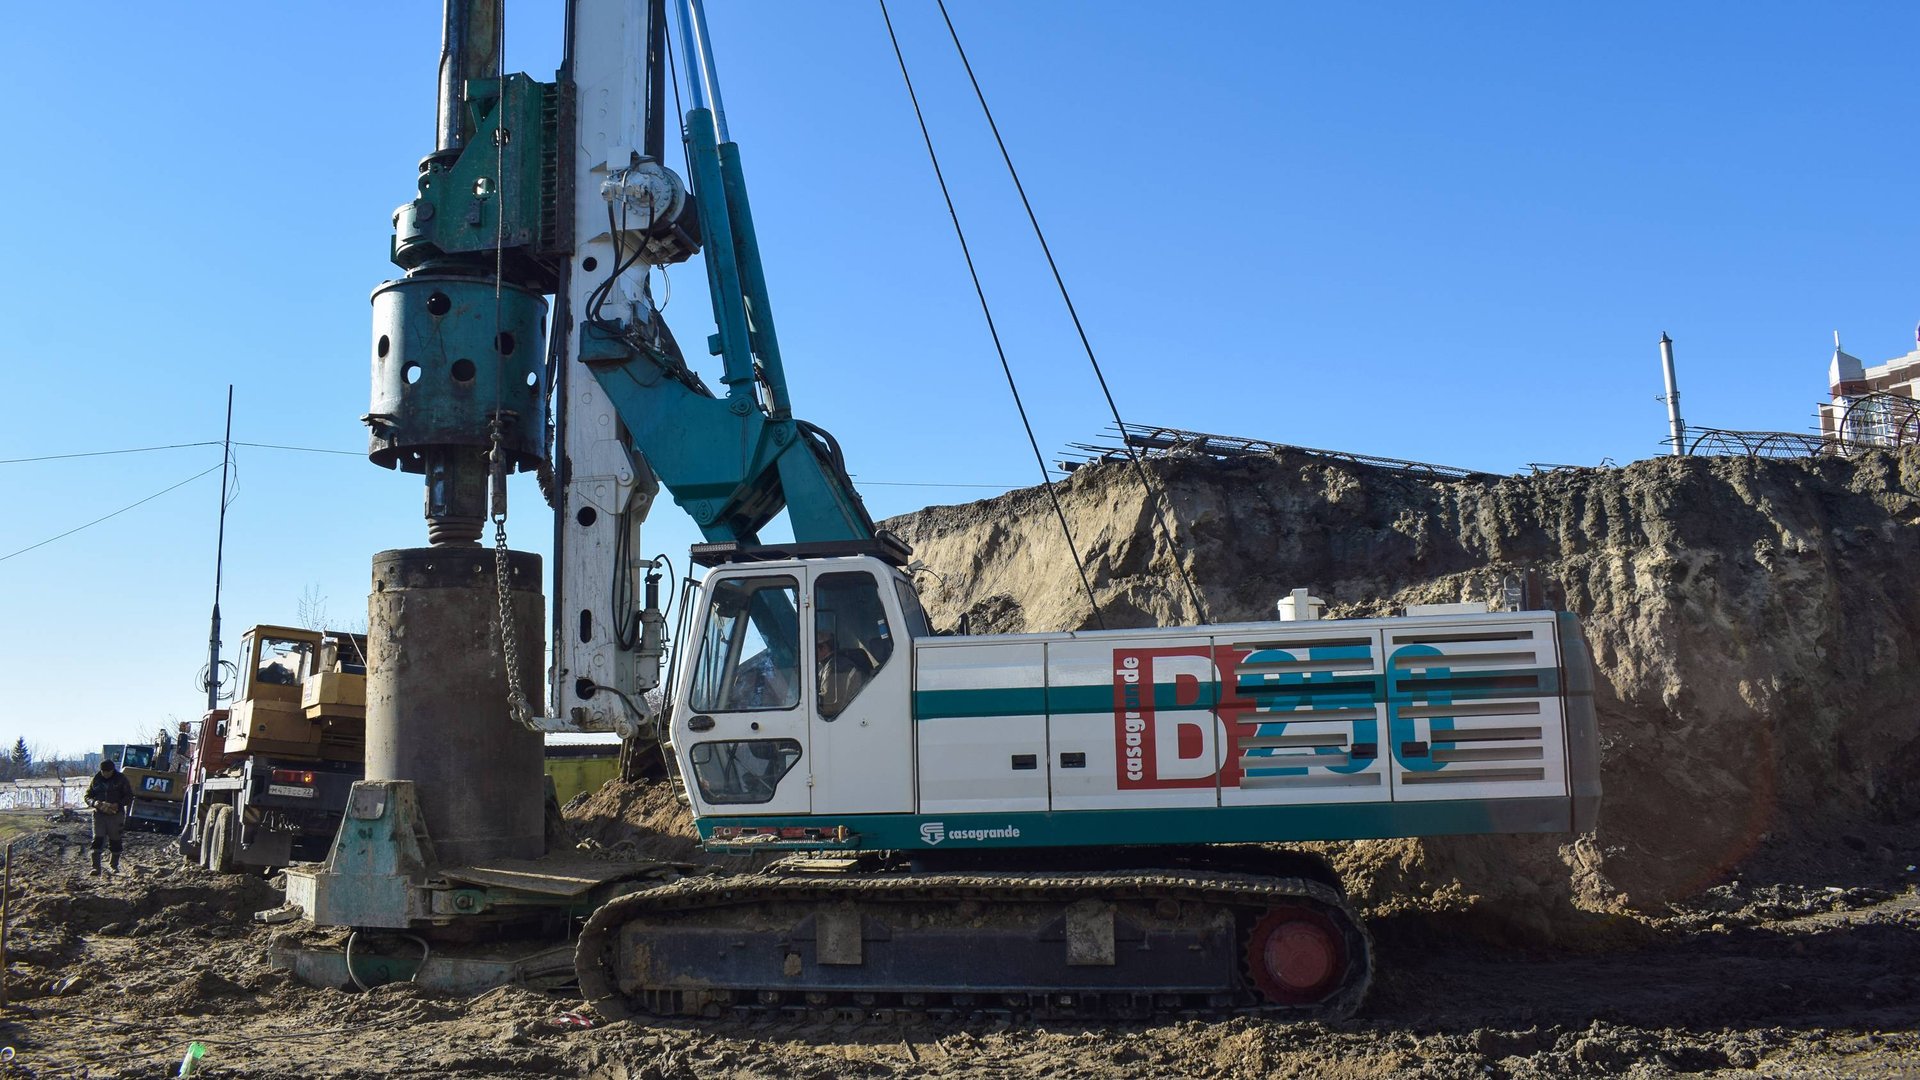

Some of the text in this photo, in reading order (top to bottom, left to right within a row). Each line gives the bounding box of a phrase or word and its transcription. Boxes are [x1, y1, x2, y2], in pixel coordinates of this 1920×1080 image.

[1116, 657, 1145, 781] casagrande
[146, 777, 169, 792] CAT
[948, 825, 1020, 841] casagrande
